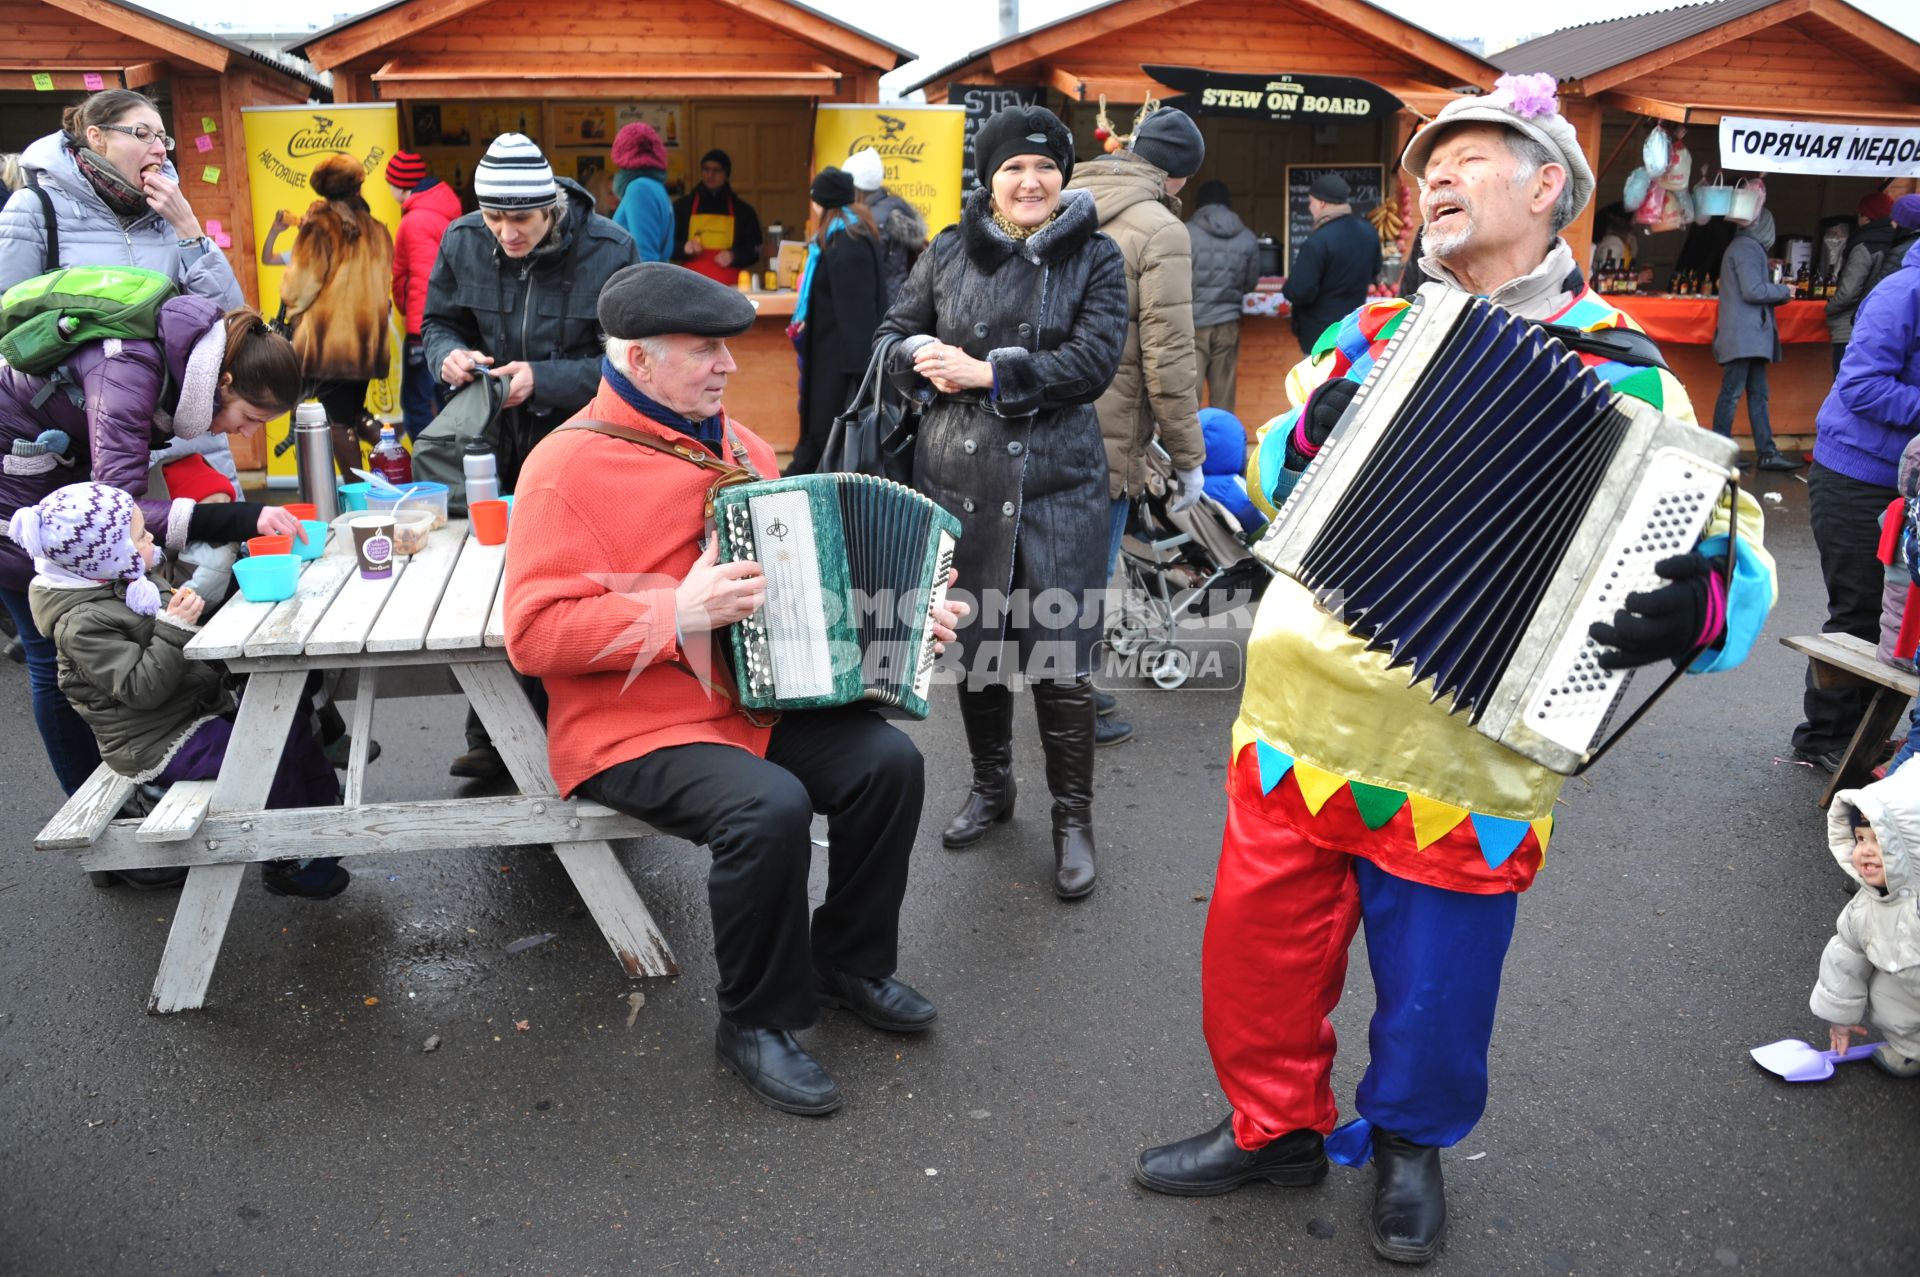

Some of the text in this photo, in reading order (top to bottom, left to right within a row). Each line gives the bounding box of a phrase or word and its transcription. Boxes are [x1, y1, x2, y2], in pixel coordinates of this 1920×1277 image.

[1202, 88, 1371, 116] STEW ON BOARD
[287, 127, 355, 158] Cacaolat
[1731, 129, 1844, 159] ГОРЯЧАЯ
[257, 147, 308, 189] НАСТОЯЩЕЕ
